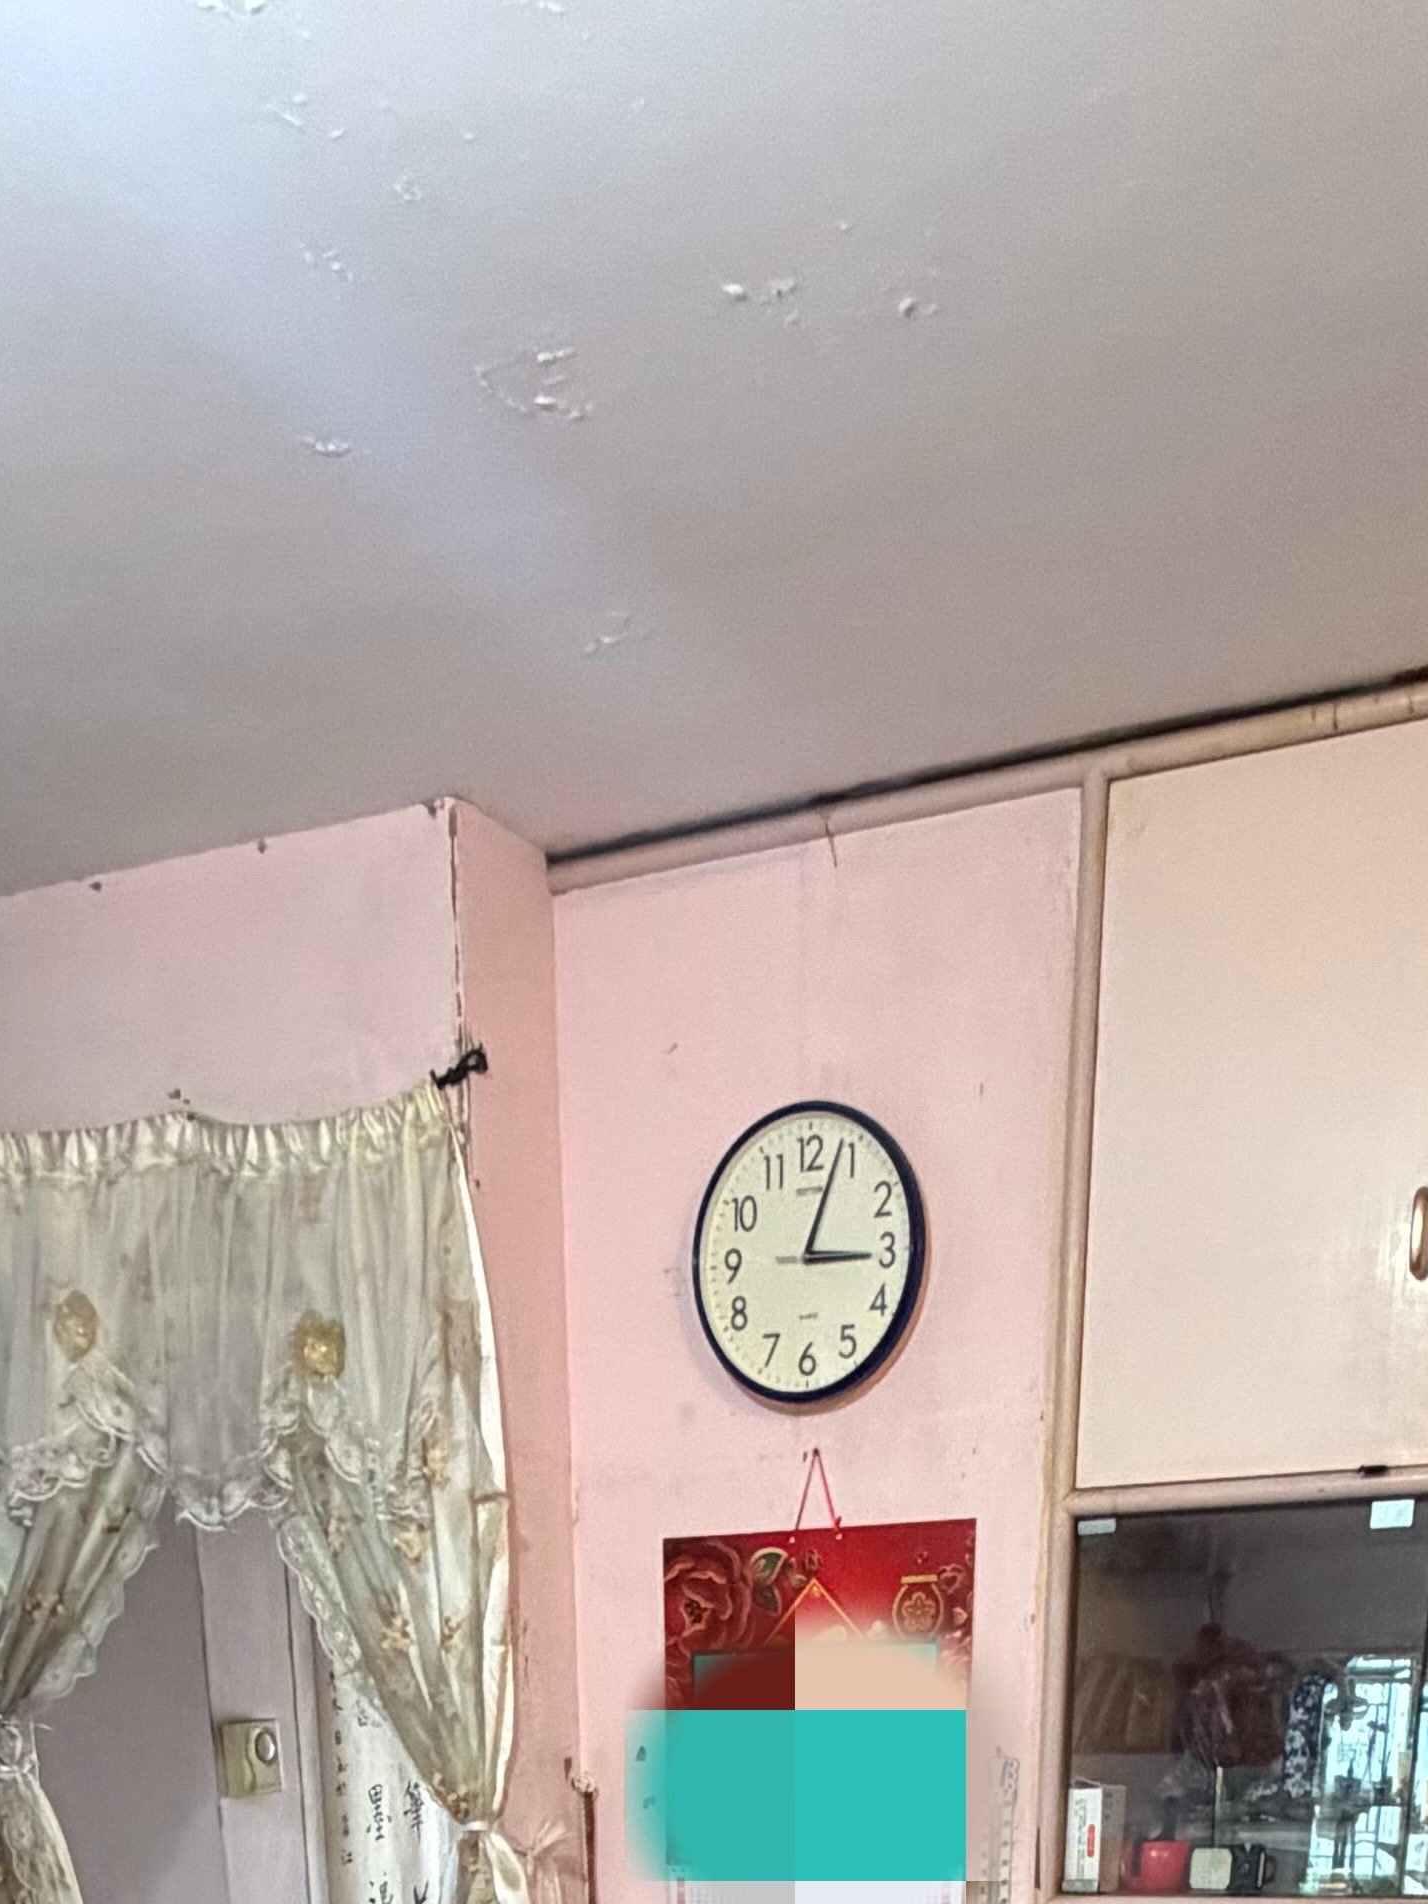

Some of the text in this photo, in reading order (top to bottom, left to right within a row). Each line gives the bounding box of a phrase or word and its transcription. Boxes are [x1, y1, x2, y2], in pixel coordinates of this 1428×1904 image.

[798, 1134, 825, 1173] 12
[847, 1142, 856, 1179] 1
[764, 1154, 785, 1191] 11
[732, 1194, 758, 1233] 10
[873, 1181, 893, 1219] 2
[723, 1248, 743, 1285] 9
[877, 1232, 896, 1269] 3
[729, 1295, 748, 1332] 8
[869, 1283, 888, 1317] 4
[762, 1333, 781, 1369] 7
[798, 1341, 817, 1377] 6
[838, 1324, 858, 1360] 5
